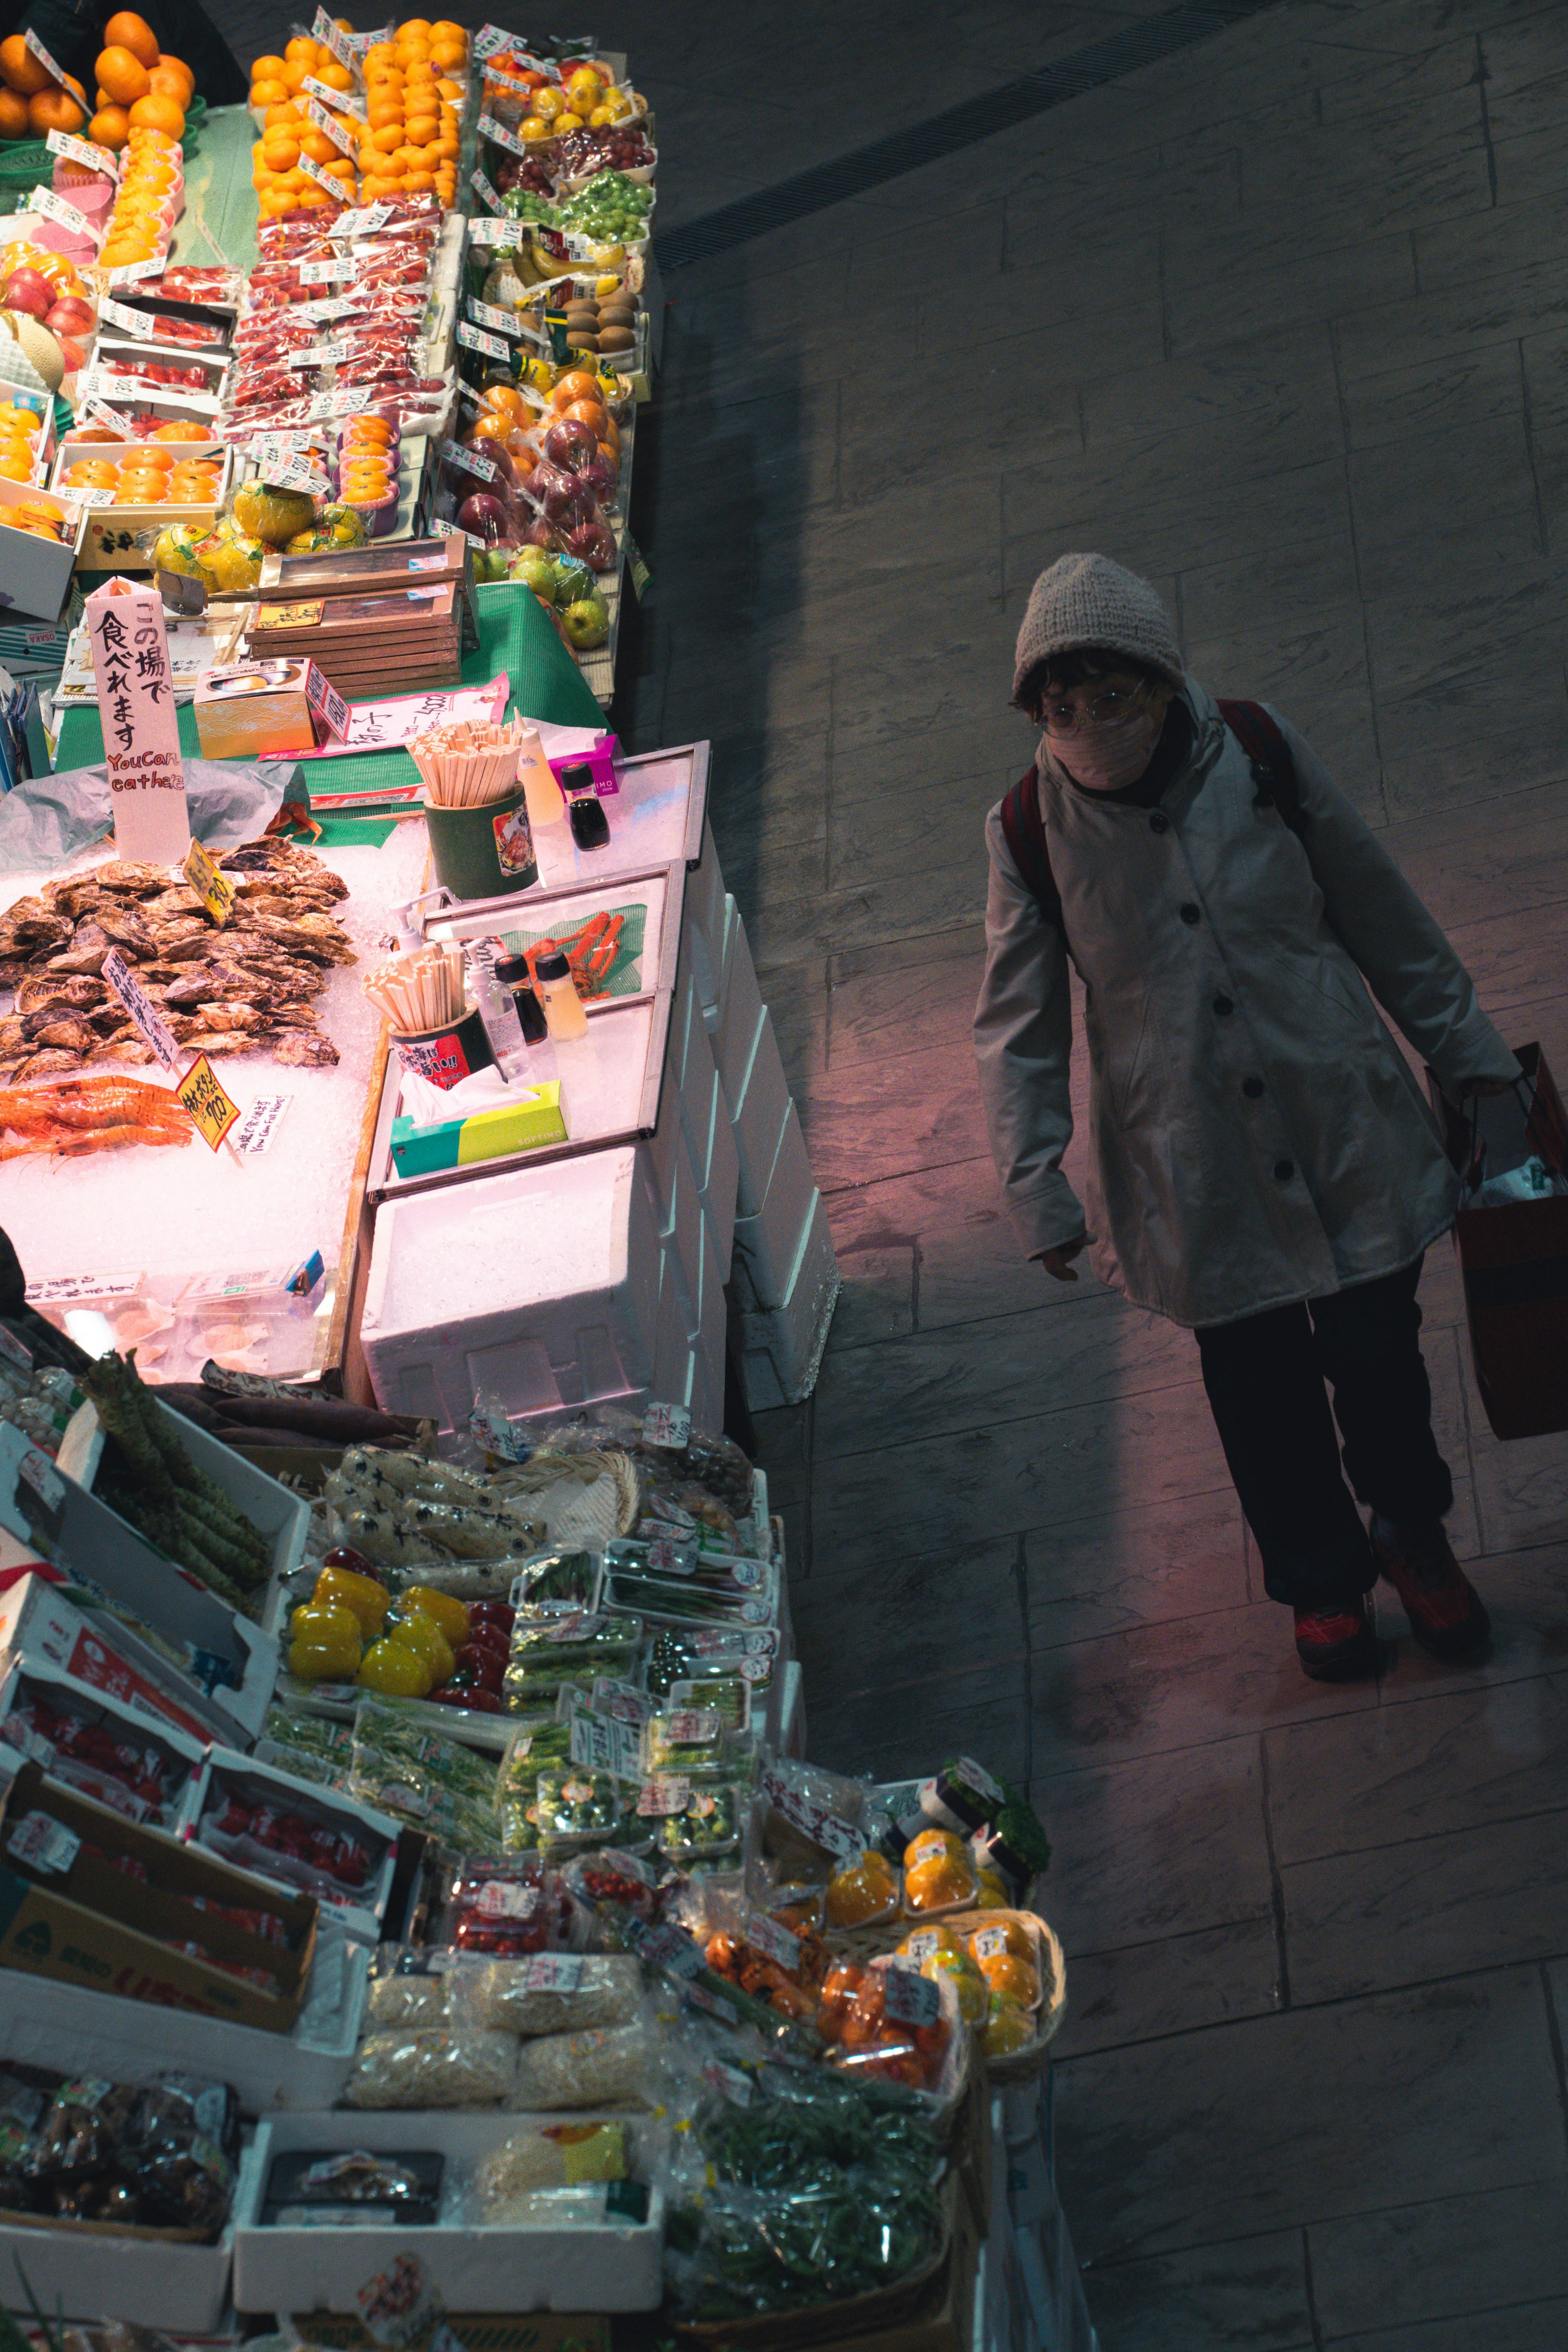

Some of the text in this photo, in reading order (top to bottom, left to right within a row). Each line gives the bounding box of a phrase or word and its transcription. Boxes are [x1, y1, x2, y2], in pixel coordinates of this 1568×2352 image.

[504, 221, 519, 238] 180
[337, 261, 350, 276] 600
[501, 314, 517, 332] 380
[328, 345, 344, 358] 630
[491, 339, 503, 355] 480
[88, 376, 100, 393] あまおう
[115, 379, 131, 396] 1300
[348, 393, 364, 412] 680
[291, 432, 308, 446] 400
[266, 448, 279, 462] せとか
[291, 457, 309, 473] 500
[303, 481, 325, 493] 400
[91, 489, 111, 504] 5400
[29, 632, 55, 643] OSAKA
[134, 602, 171, 704] この場で
[94, 610, 136, 752] 食べれます
[345, 712, 392, 746] 数の子
[108, 968, 173, 1065] お刺身します
[398, 1047, 438, 1068] 日本海は
[264, 1114, 277, 1124] Eat
[259, 1125, 270, 1136] Can
[517, 1131, 562, 1145] SOFTIMO
[250, 1139, 264, 1152] You
[27, 1276, 95, 1291] の場で
